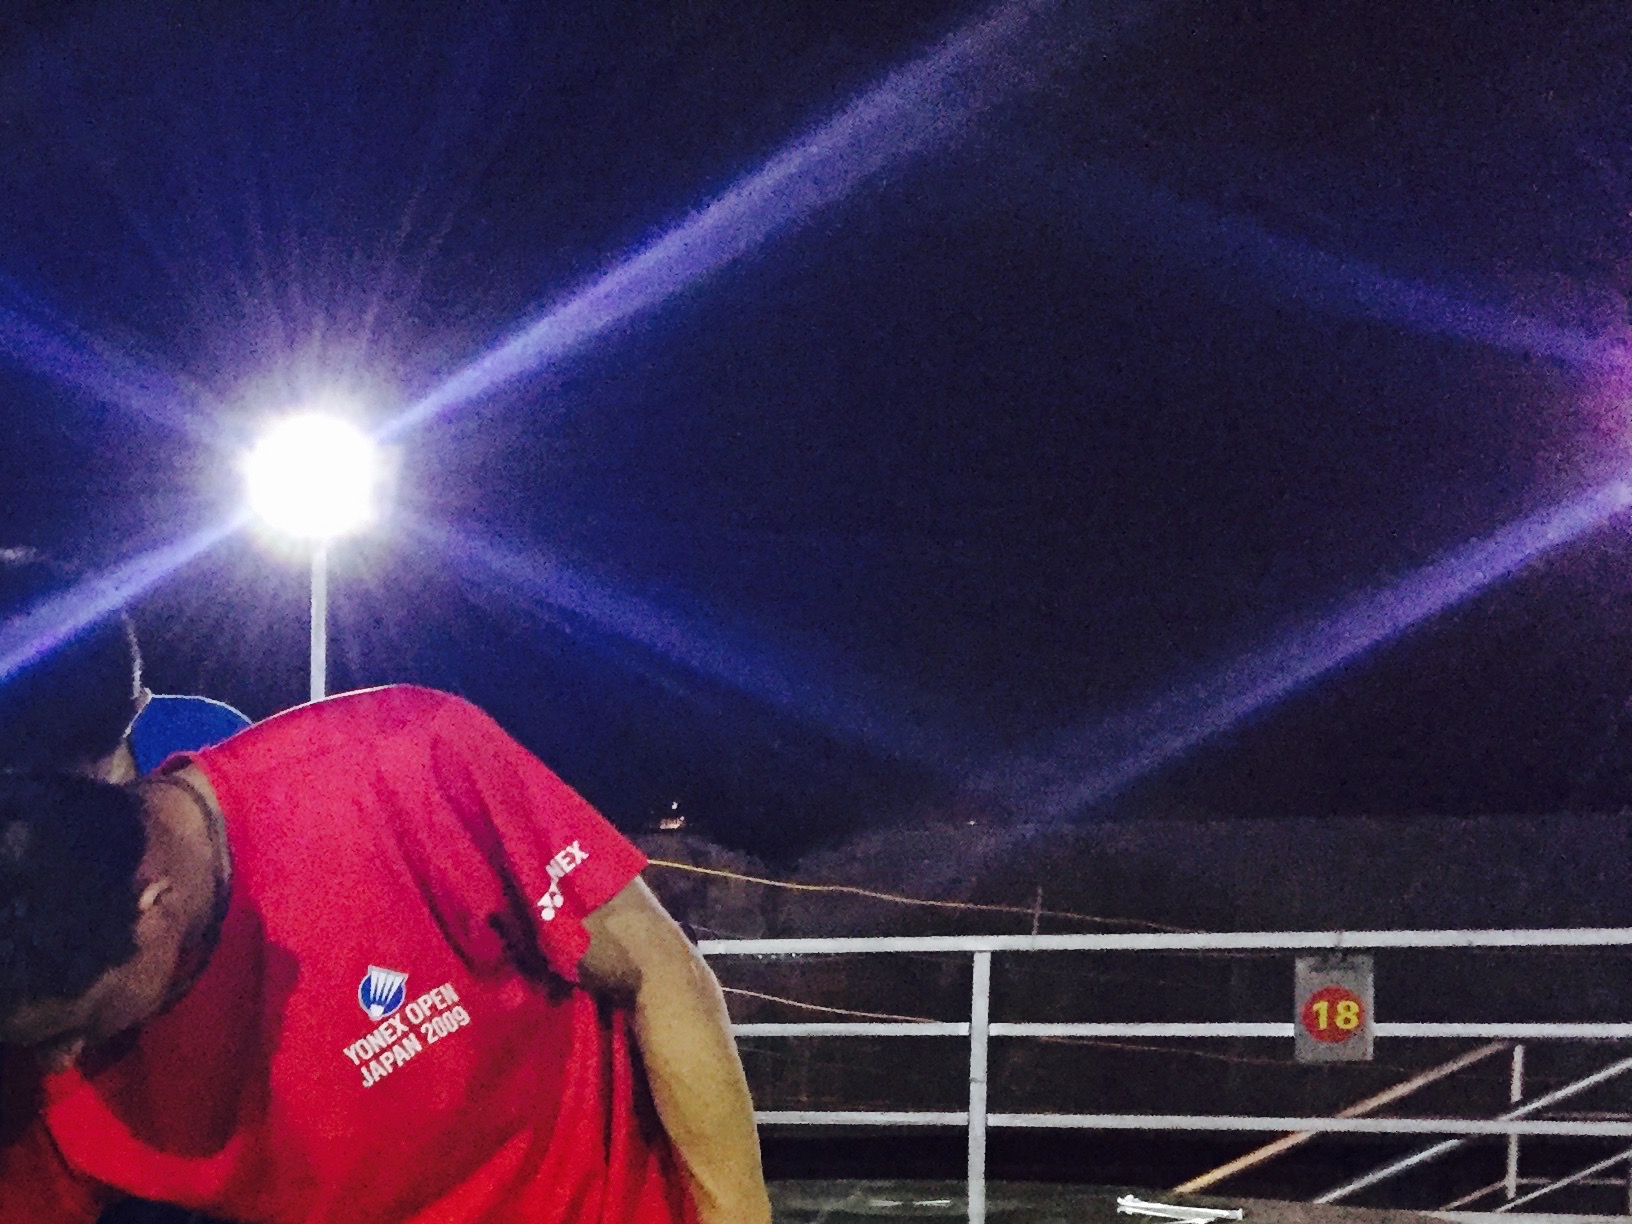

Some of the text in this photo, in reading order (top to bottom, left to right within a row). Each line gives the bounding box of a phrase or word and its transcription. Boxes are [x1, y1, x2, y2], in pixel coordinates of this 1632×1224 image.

[342, 982, 460, 1066] YONEX OPEN
[360, 1005, 471, 1088] JAPAN 2009
[1312, 999, 1361, 1031] 18
